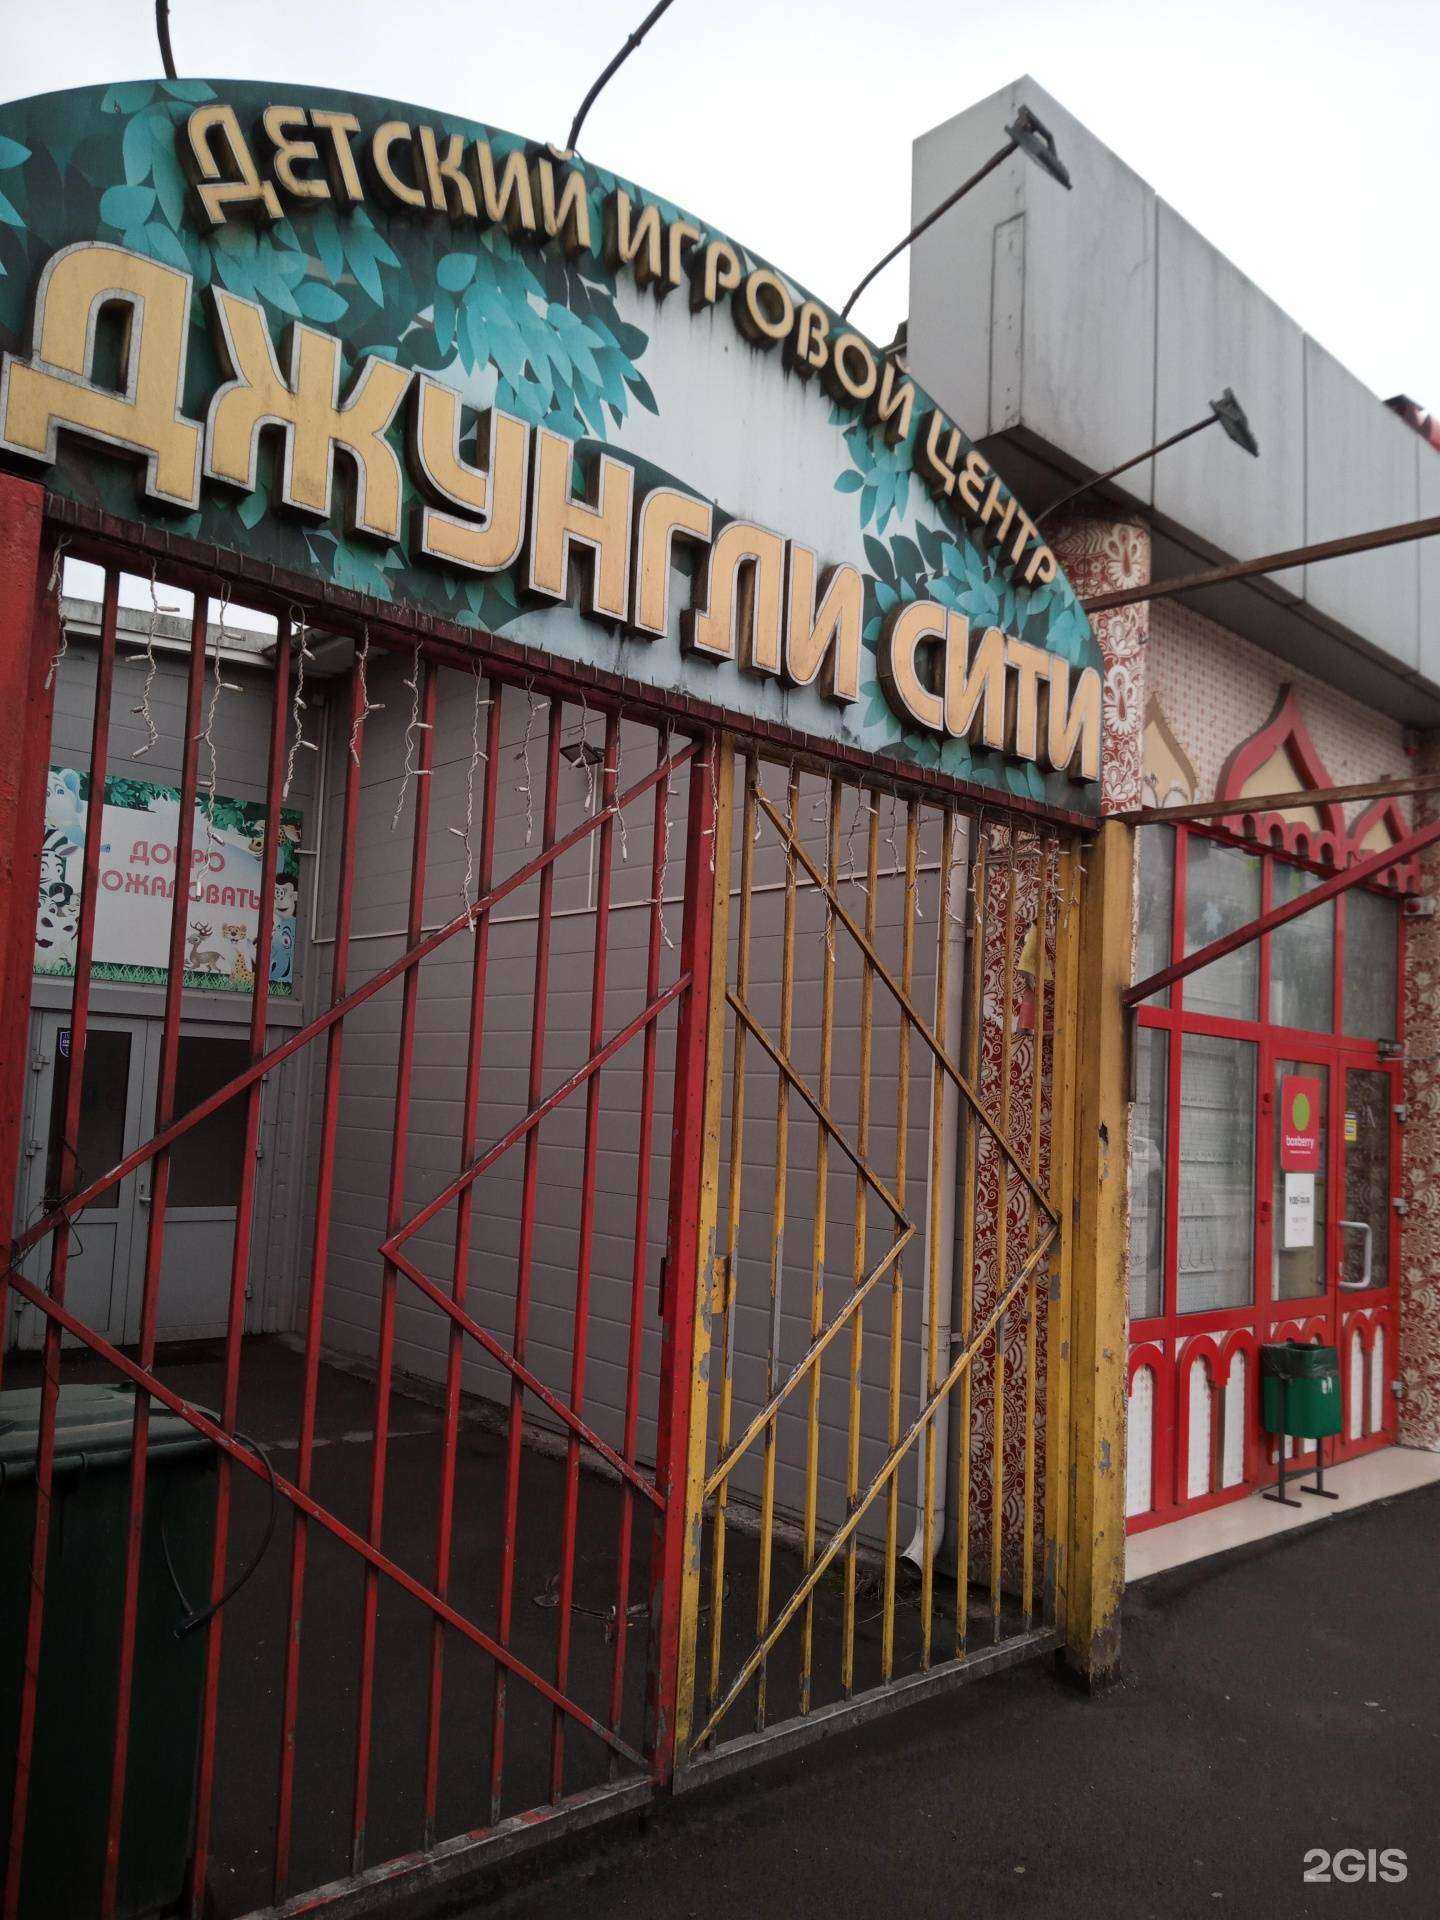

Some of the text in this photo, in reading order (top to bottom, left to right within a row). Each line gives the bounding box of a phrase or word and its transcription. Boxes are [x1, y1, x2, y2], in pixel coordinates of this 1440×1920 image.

[186, 103, 1058, 585] ДЕТСКИЙ ИГРОВОЙ ЦЕНТР
[0, 240, 1103, 784] ДЖУНГЛИ СИТИ
[98, 869, 261, 911] ОЖАОВАТЬ
[129, 840, 226, 873] ДОРО
